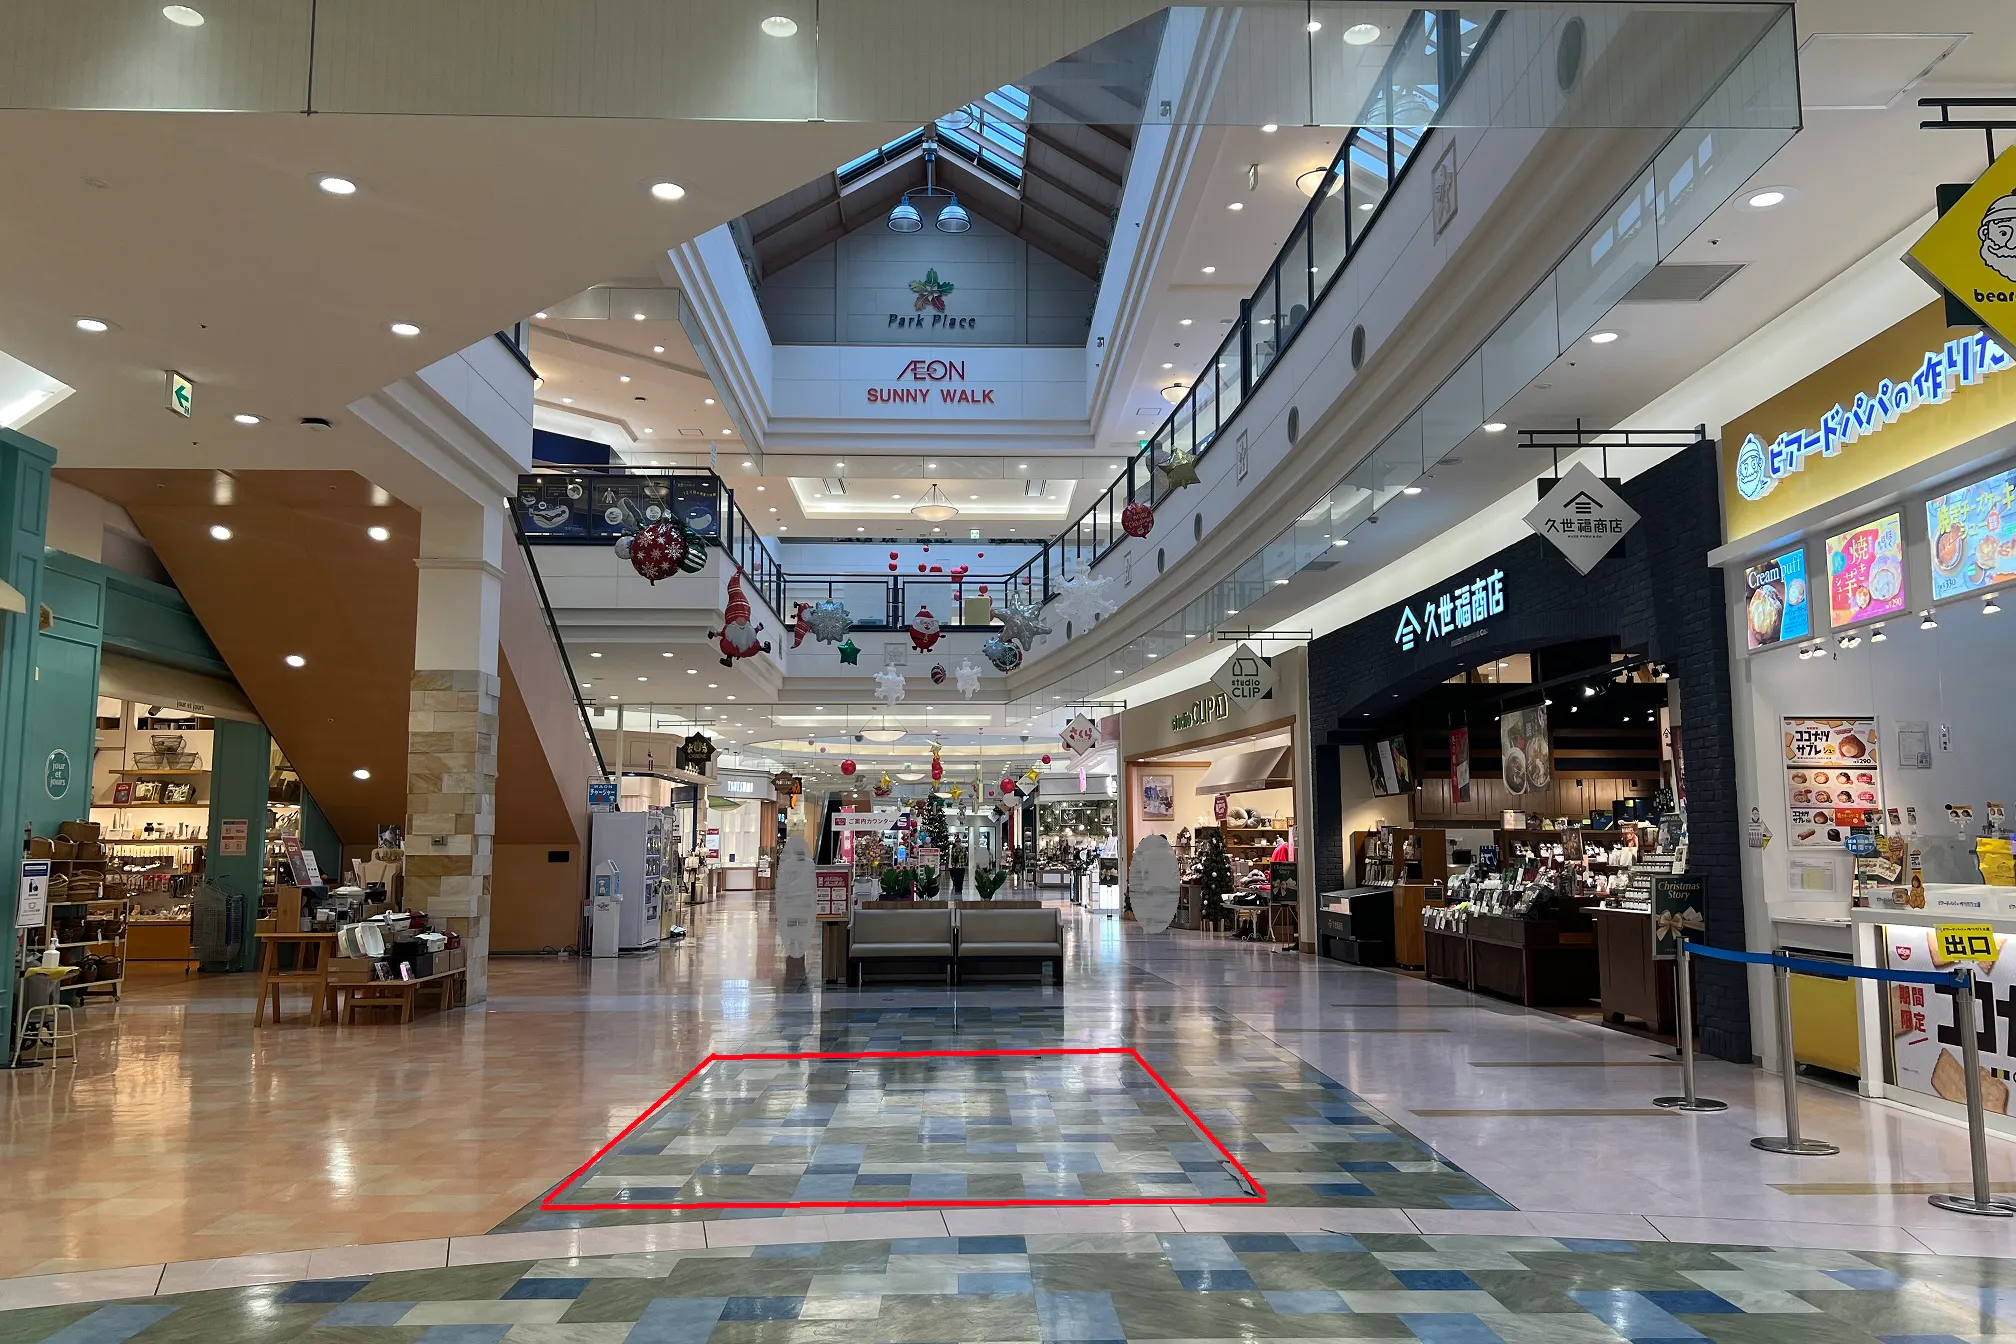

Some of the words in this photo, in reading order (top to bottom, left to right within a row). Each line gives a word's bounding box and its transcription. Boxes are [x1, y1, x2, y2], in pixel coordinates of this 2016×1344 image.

[887, 314, 924, 329] Park
[931, 314, 976, 329] Place
[867, 388, 930, 403] SUNNY
[940, 389, 994, 403] WALK
[1544, 518, 1622, 533] 久世福商店
[1748, 566, 1780, 588] Cream
[1780, 553, 1802, 582] puff
[1424, 569, 1504, 642] 久世福商店
[1231, 687, 1260, 698] CLIP
[176, 700, 187, 708] jour
[187, 701, 193, 709] et
[193, 702, 204, 711] jours
[1192, 695, 1216, 726] CLIP
[1069, 726, 1093, 740] さくら
[1795, 731, 1831, 742] ココナッツ
[1796, 742, 1822, 756] サブレ
[52, 761, 66, 771] jour
[50, 778, 66, 787] jours
[1658, 881, 1701, 891] Christmas
[1668, 889, 1690, 901] Story
[1945, 935, 1991, 955] 出口
